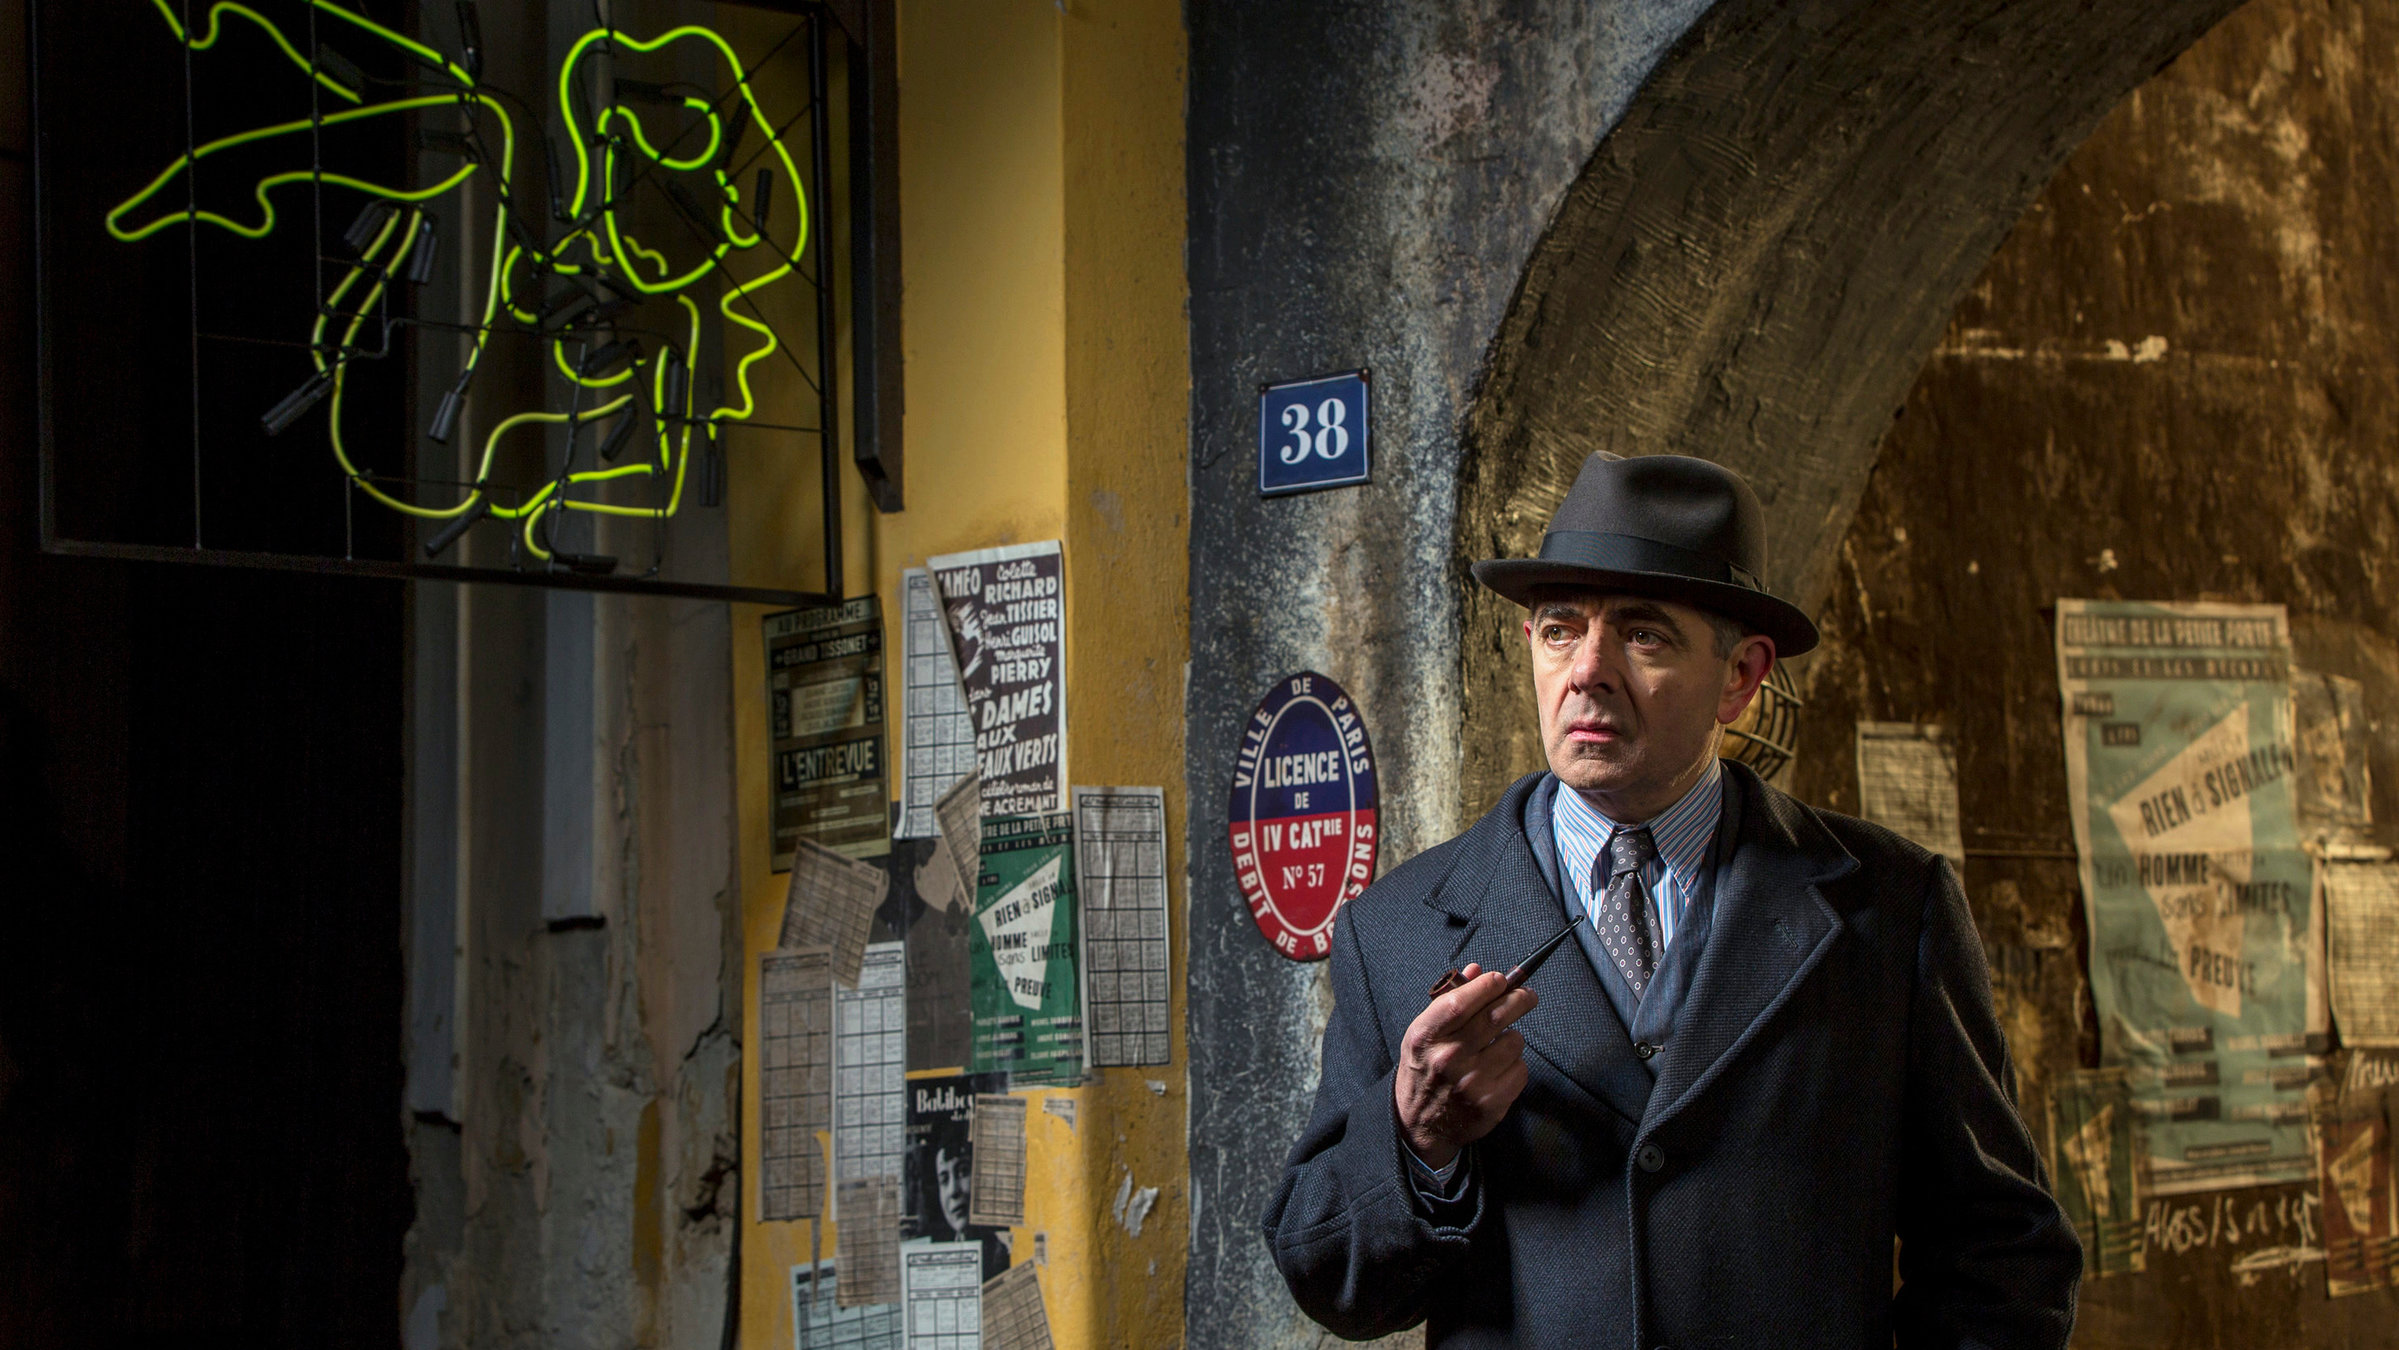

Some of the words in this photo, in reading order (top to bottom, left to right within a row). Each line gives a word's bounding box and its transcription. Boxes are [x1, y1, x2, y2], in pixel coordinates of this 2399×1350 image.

[1281, 398, 1349, 464] 38
[938, 567, 981, 598] AMÉO
[997, 560, 1037, 581] Colette
[985, 576, 1057, 604] RICHARD
[1006, 598, 1057, 624] TISSIER
[1011, 621, 1057, 646] GUISOL
[991, 657, 1051, 685] PIERRY
[981, 680, 1053, 731] DAMES
[977, 724, 1017, 750] AUX
[1235, 708, 1273, 788] VILLE
[1291, 677, 1312, 695] DE
[1331, 694, 1370, 775] PARIS
[783, 740, 874, 784] L'ENTREVUE
[1015, 733, 1057, 772] VERTS
[1264, 750, 1340, 789] LICENCE
[1294, 792, 1310, 810] DE
[2140, 786, 2192, 837] RIEN
[1263, 824, 1283, 852] IV
[1307, 863, 1325, 888] 57
[2139, 853, 2208, 887] HOMME
[1233, 832, 1272, 919] DEBIT
[1275, 930, 1298, 954] DE
[995, 901, 1021, 928] RIEN
[992, 932, 1027, 951] HOMME
[1014, 977, 1052, 999] PREUVE
